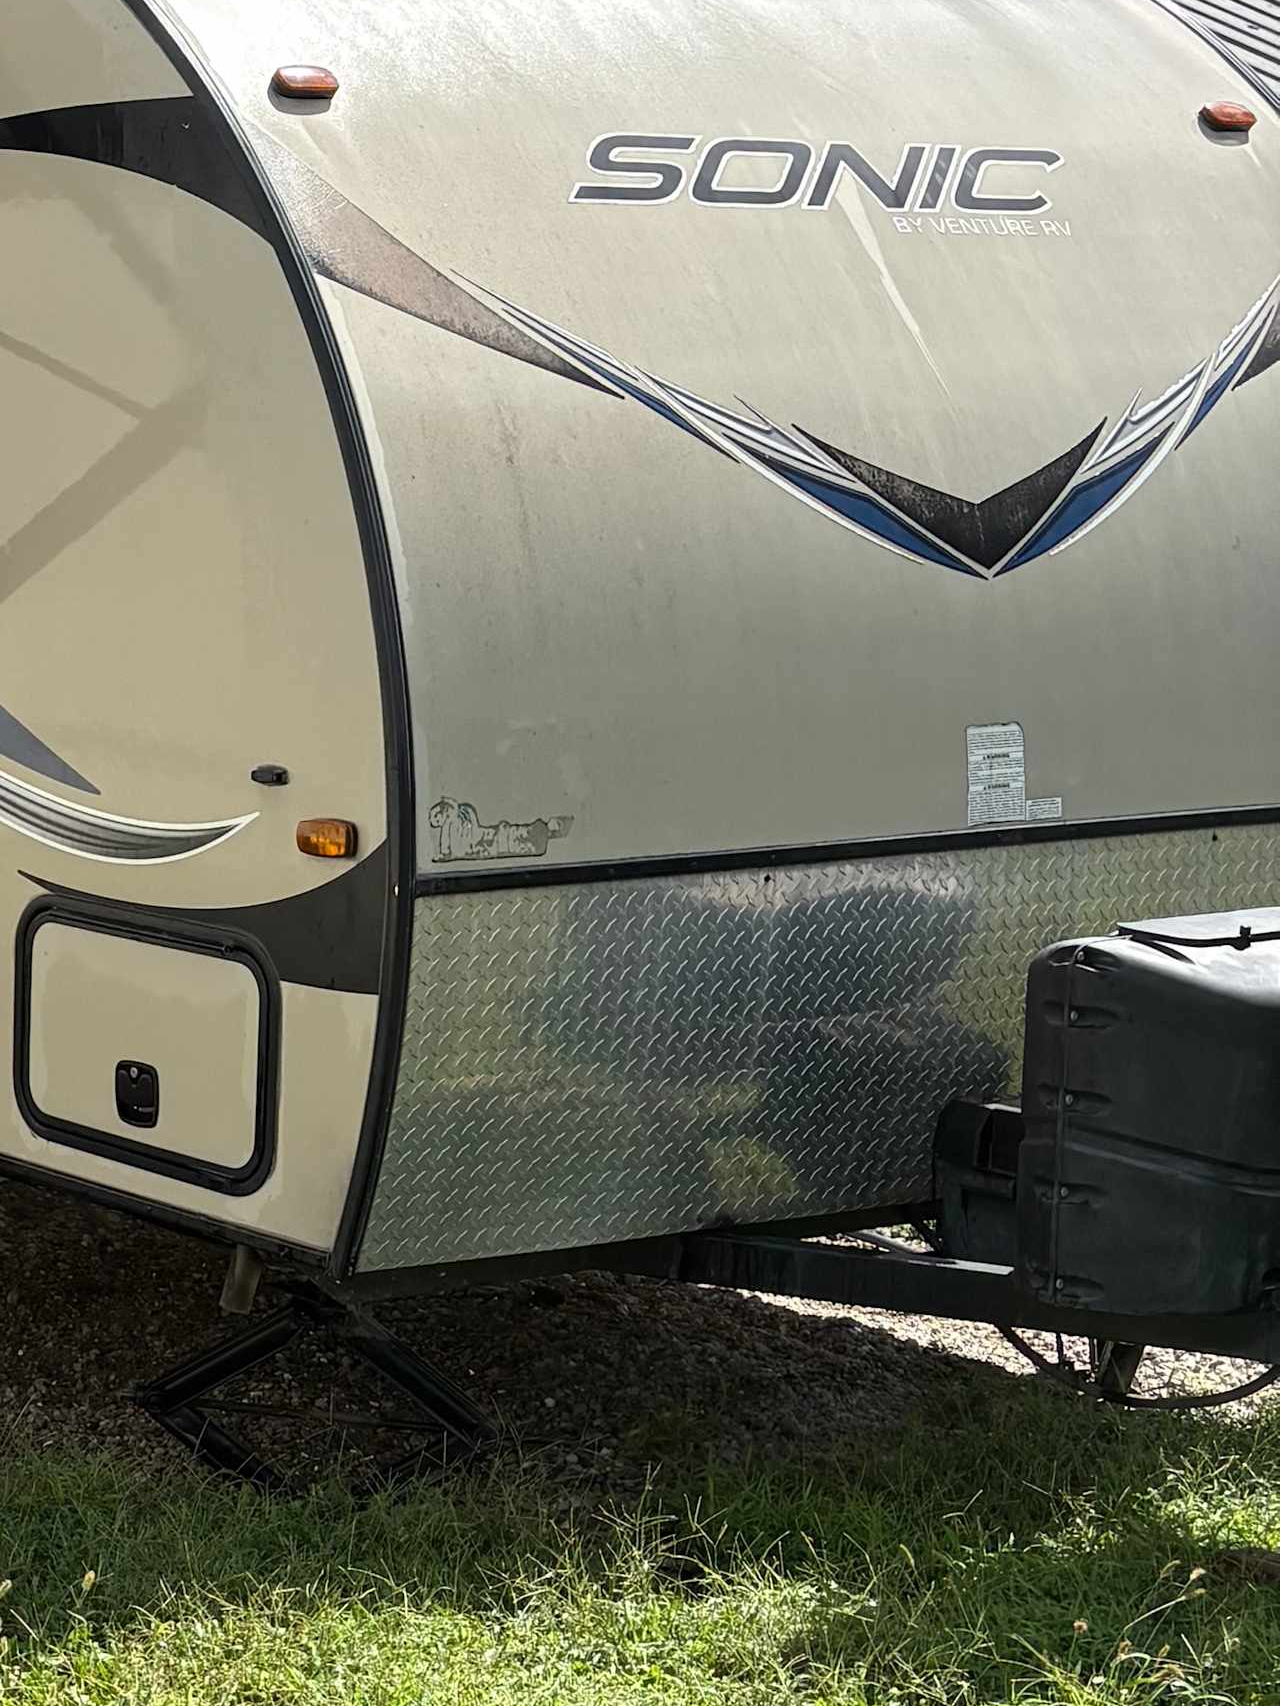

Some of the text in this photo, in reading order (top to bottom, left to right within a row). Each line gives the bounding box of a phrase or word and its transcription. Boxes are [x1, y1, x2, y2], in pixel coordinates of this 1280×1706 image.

[568, 132, 1065, 215] SONIC
[892, 216, 1072, 236] BY VENTURE RV
